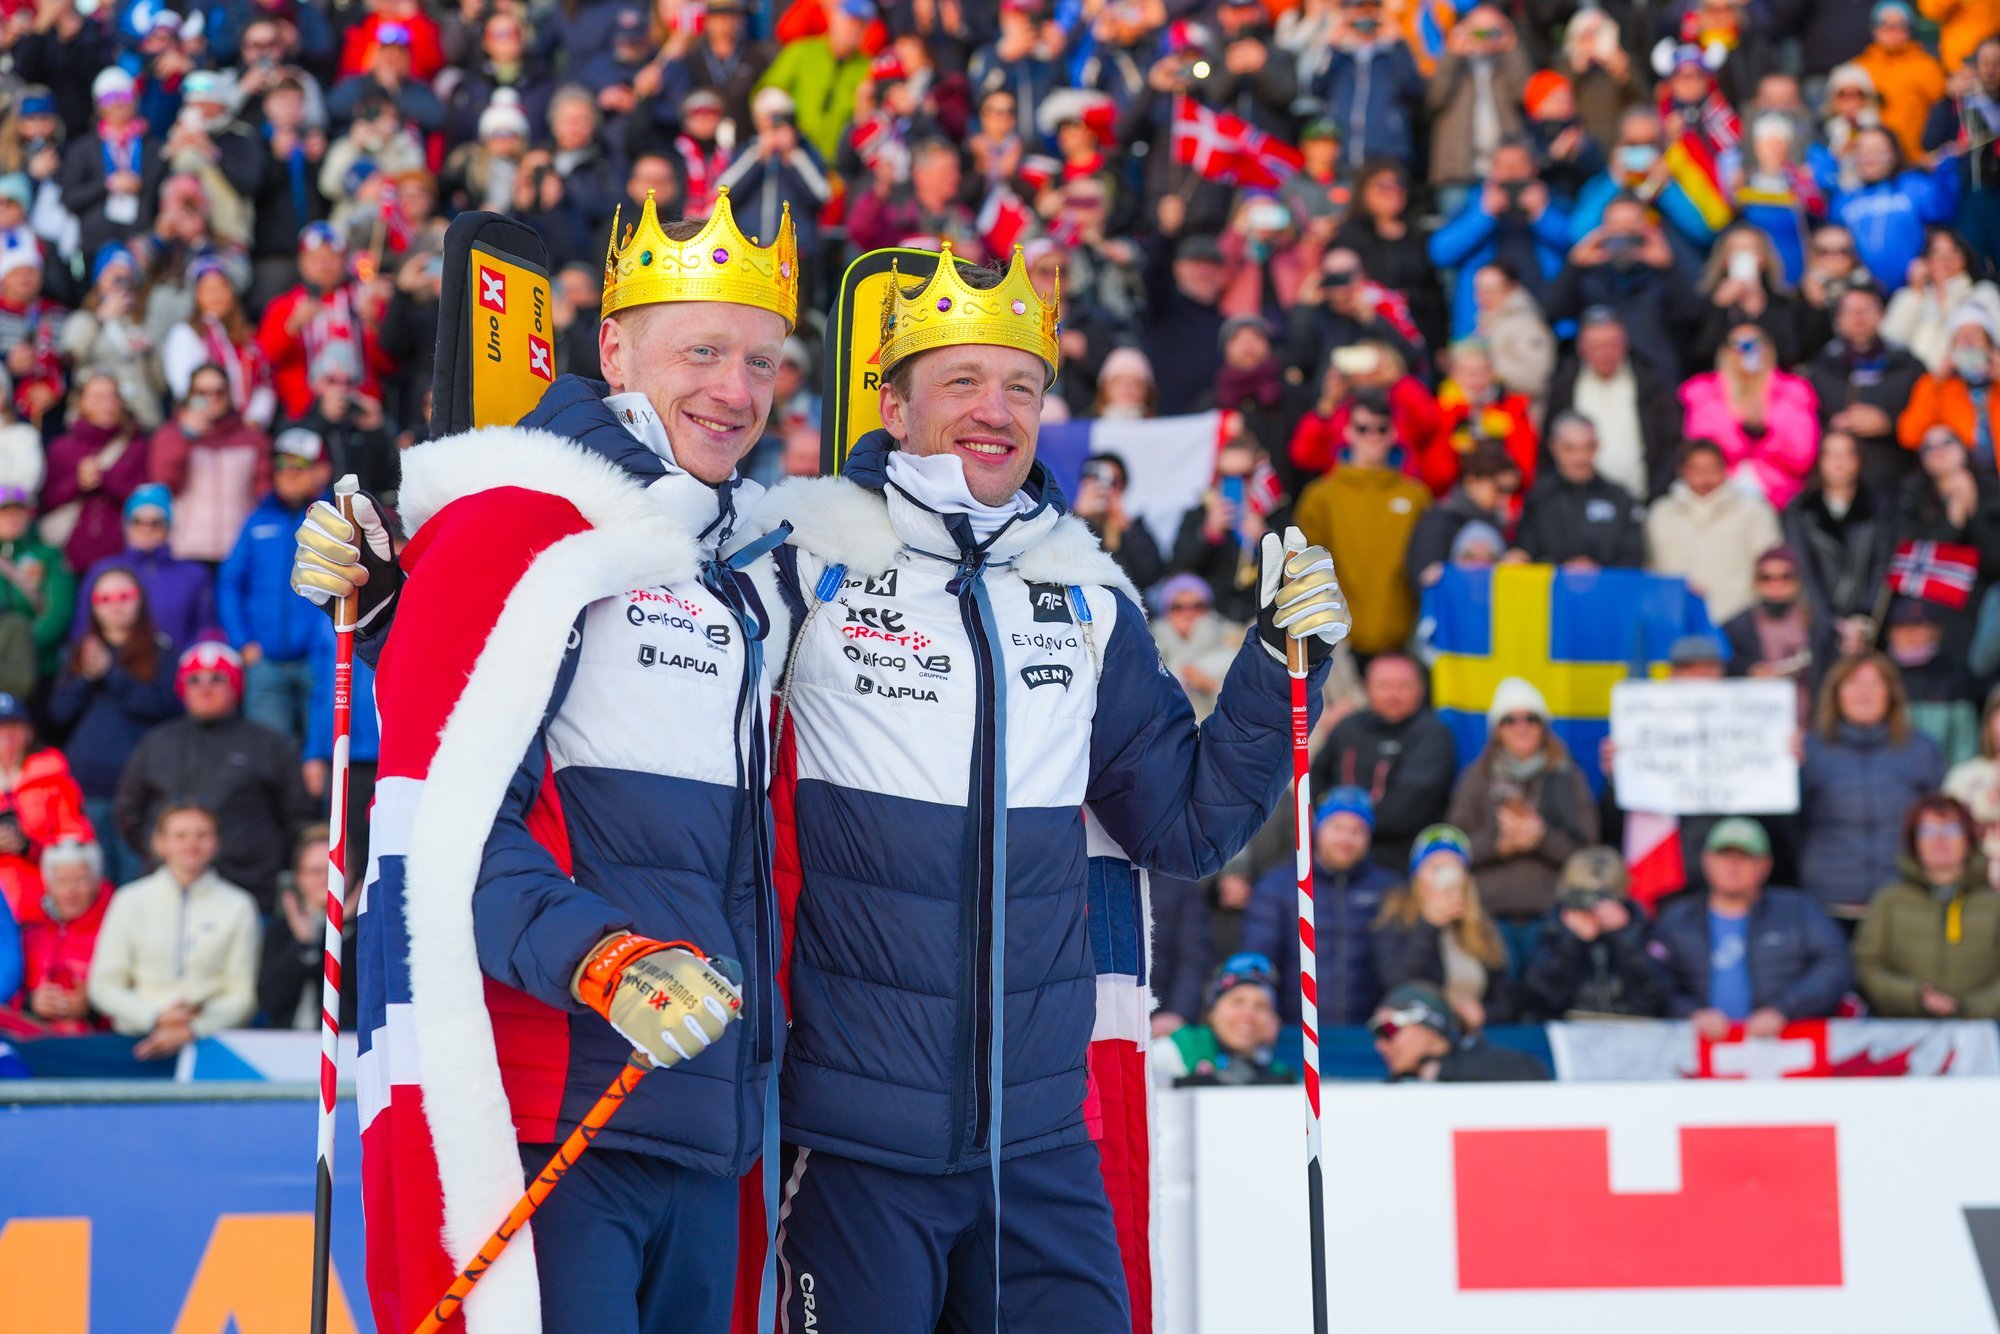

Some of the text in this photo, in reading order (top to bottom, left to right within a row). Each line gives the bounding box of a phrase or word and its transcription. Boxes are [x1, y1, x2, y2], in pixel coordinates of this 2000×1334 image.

[533, 286, 544, 333] Uno
[488, 315, 502, 362] Uno
[839, 579, 862, 588] no
[647, 611, 694, 633] elfag
[842, 626, 910, 646] CRAFT
[659, 651, 719, 676] LAPUA
[863, 653, 906, 671] elfag
[913, 654, 952, 673] VB
[918, 672, 948, 681] GRUPPEN
[877, 685, 939, 703] LAPUA
[800, 1272, 818, 1334] CRA
